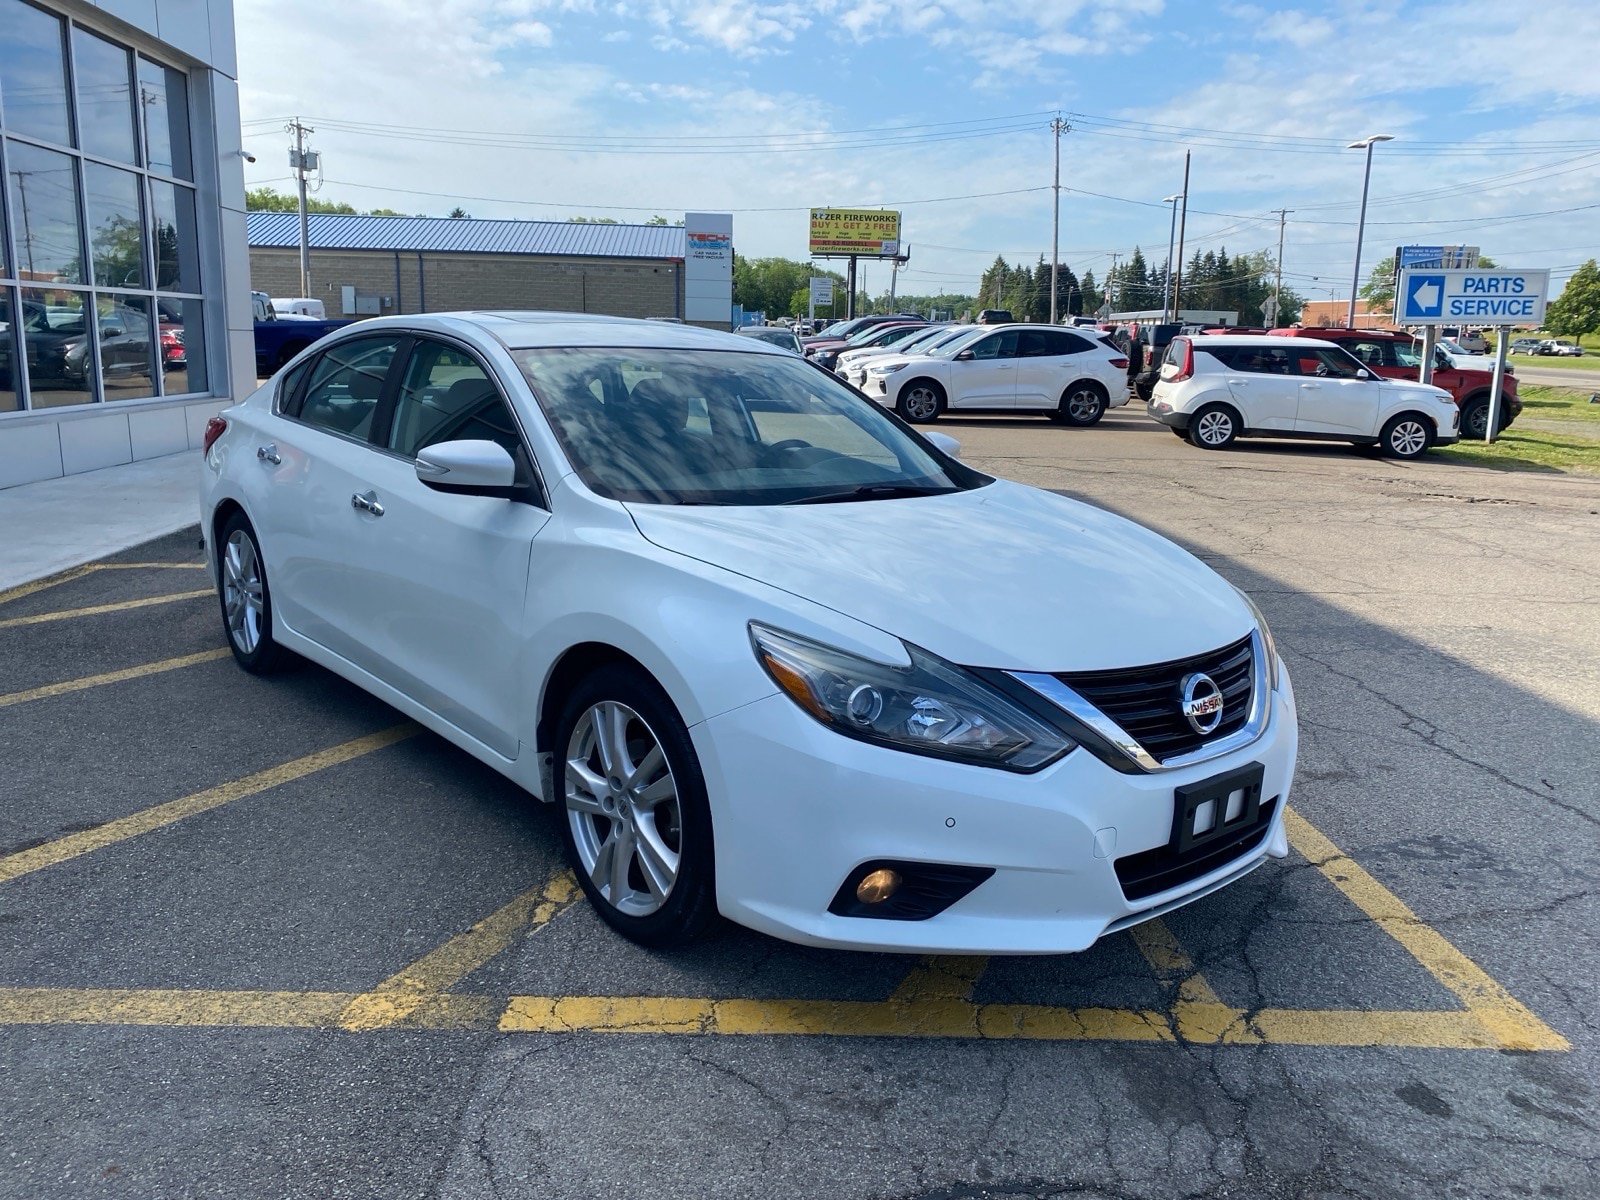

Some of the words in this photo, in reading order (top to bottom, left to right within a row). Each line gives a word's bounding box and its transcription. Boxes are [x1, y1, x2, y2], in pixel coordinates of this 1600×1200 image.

[1464, 277, 1526, 293] PARTS
[1450, 300, 1534, 316] SERVICE
[1191, 698, 1223, 713] NISSAN
